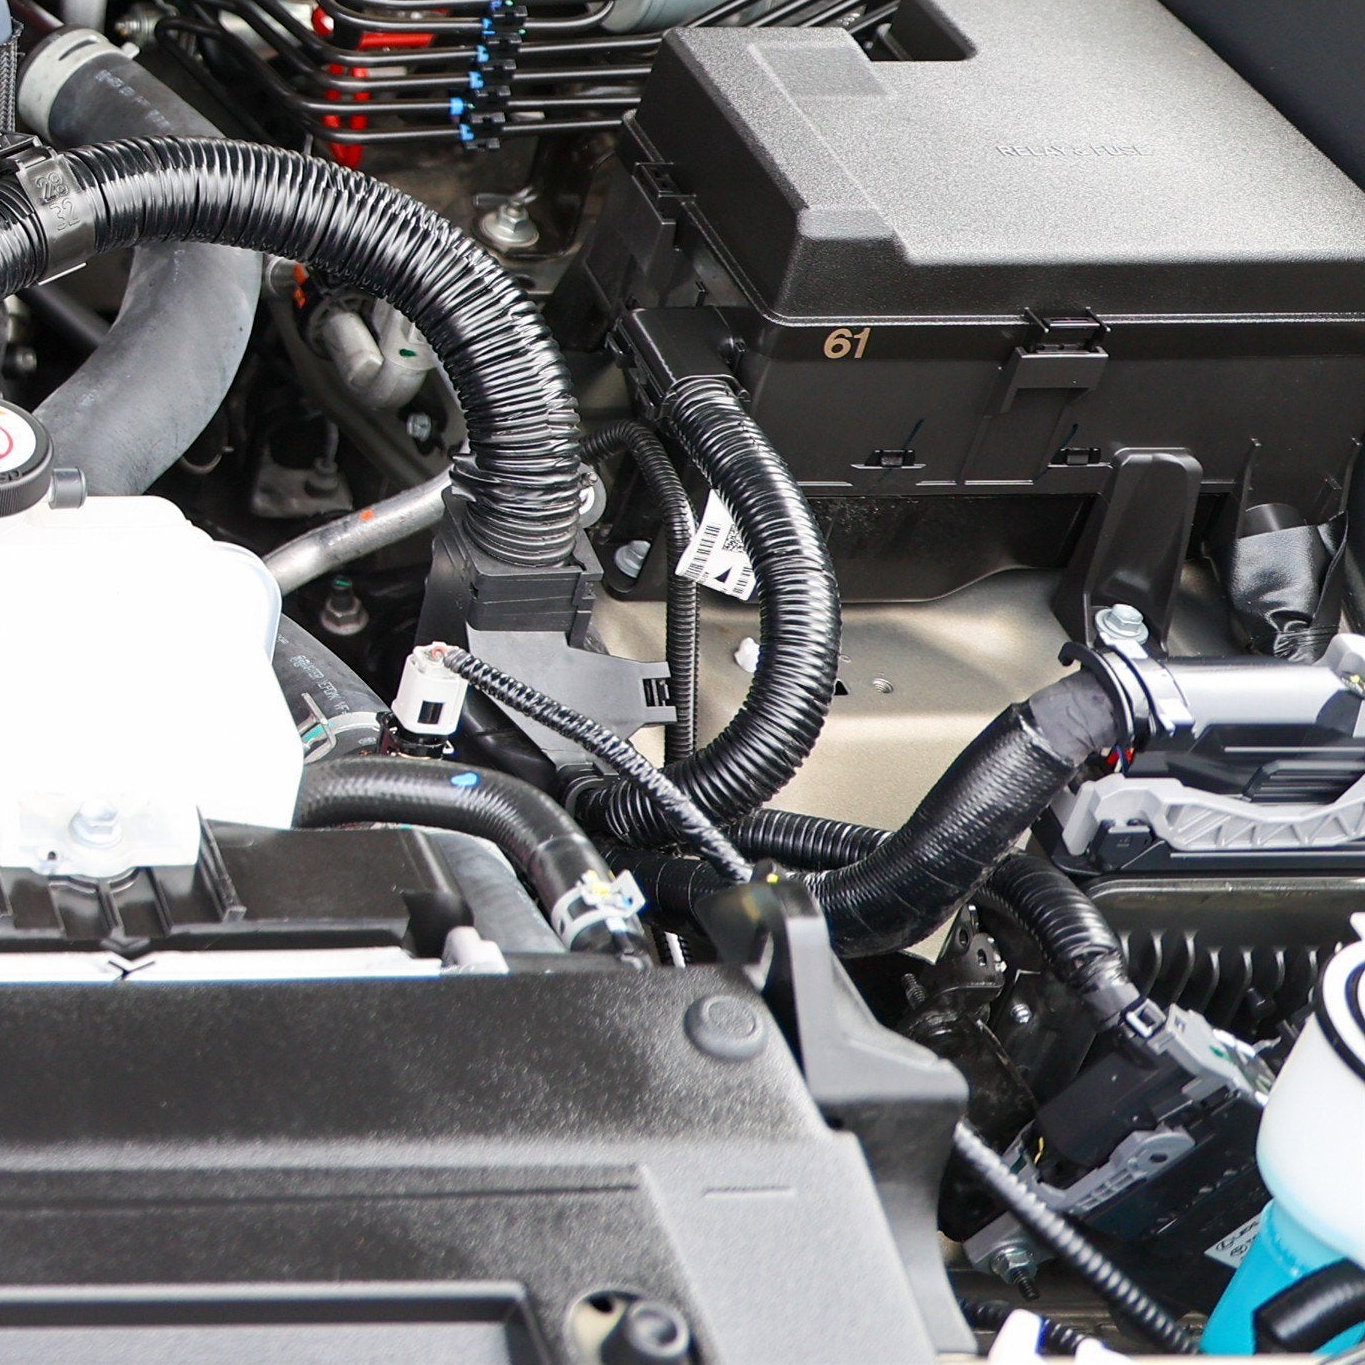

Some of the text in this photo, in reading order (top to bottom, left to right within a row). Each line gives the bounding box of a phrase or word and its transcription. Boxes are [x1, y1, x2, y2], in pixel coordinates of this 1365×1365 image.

[995, 145, 1068, 157] RELAY
[1089, 145, 1155, 157] FUSE
[48, 197, 82, 231] 32
[823, 327, 871, 359] 61
